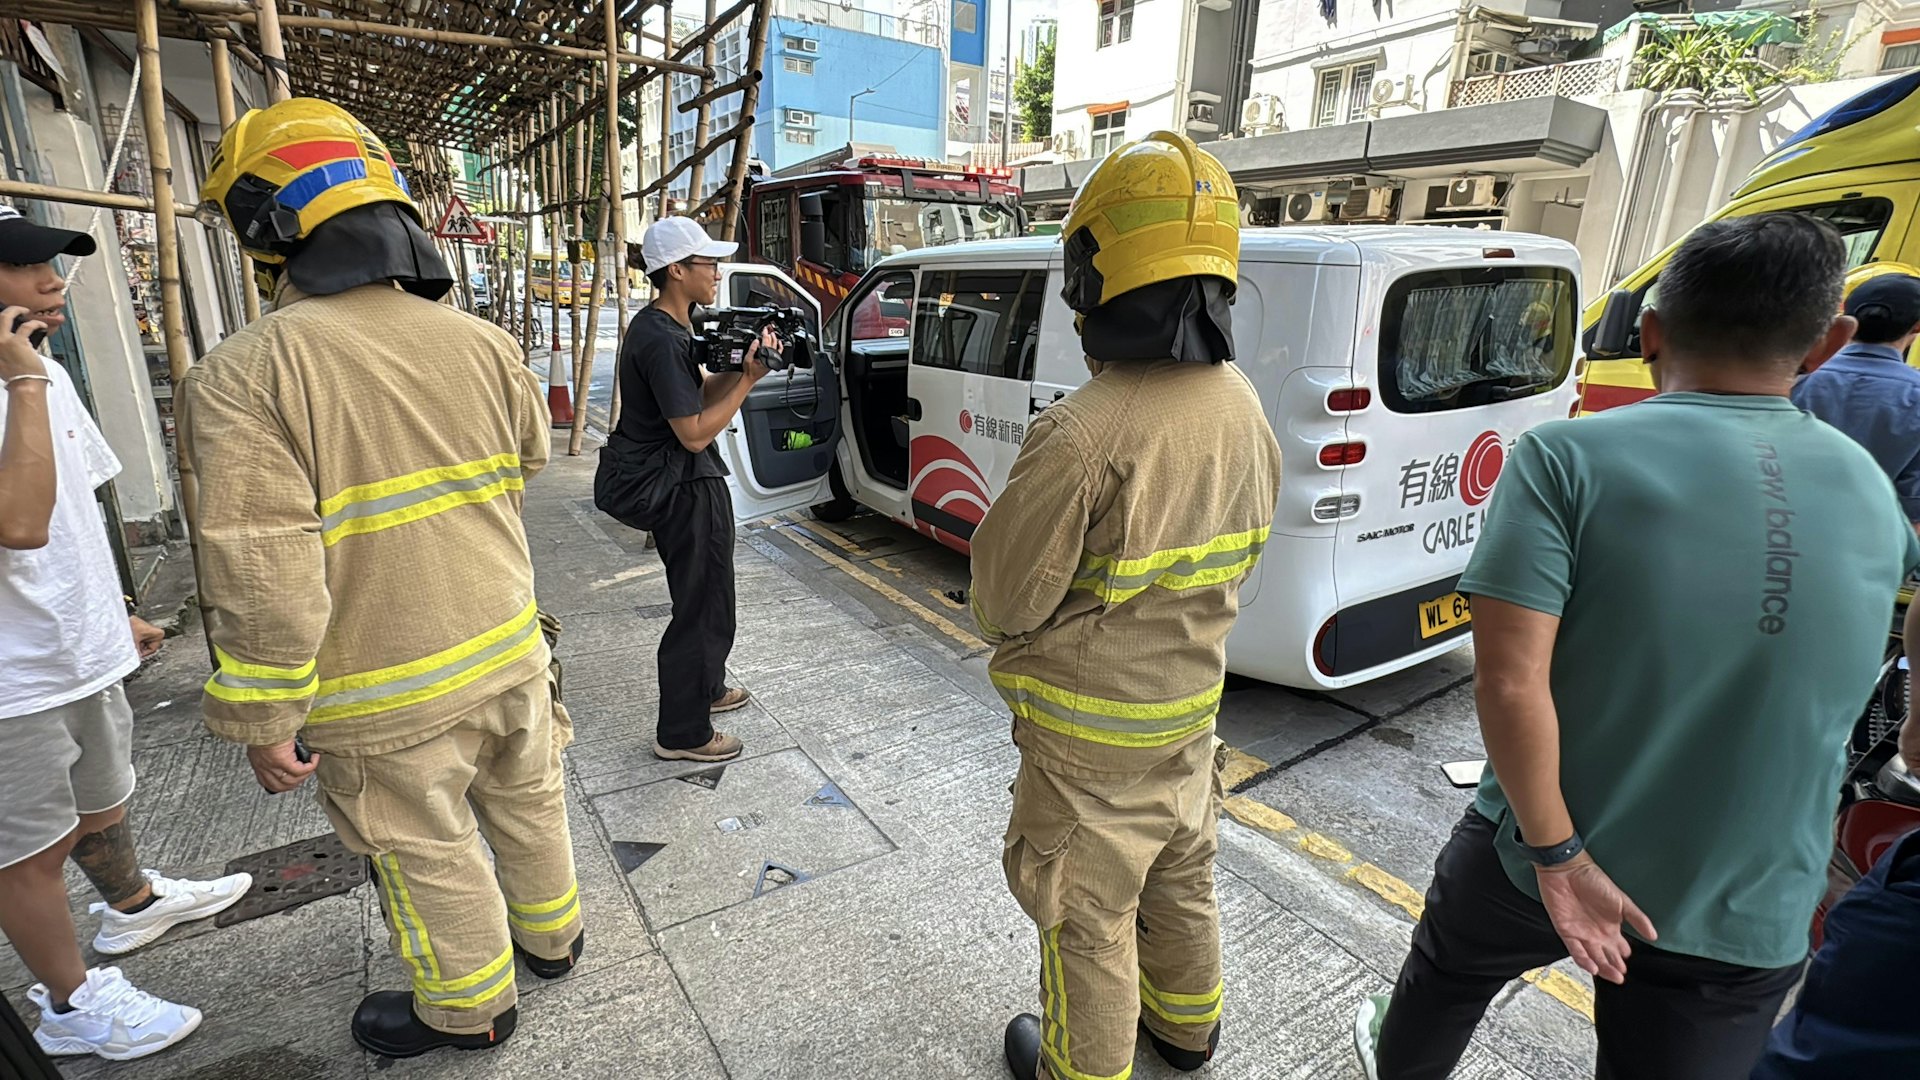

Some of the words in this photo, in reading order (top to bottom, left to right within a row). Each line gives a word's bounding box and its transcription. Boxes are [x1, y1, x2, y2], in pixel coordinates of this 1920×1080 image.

[974, 413, 1024, 446] 有線新聞
[1399, 452, 1460, 509] 有線
[1753, 442, 1788, 502] new
[1357, 530, 1383, 542] SAIC
[1383, 523, 1415, 537] MOTOR
[1422, 512, 1476, 554] CABLE
[1757, 508, 1803, 635] balance
[1426, 604, 1448, 629] WL
